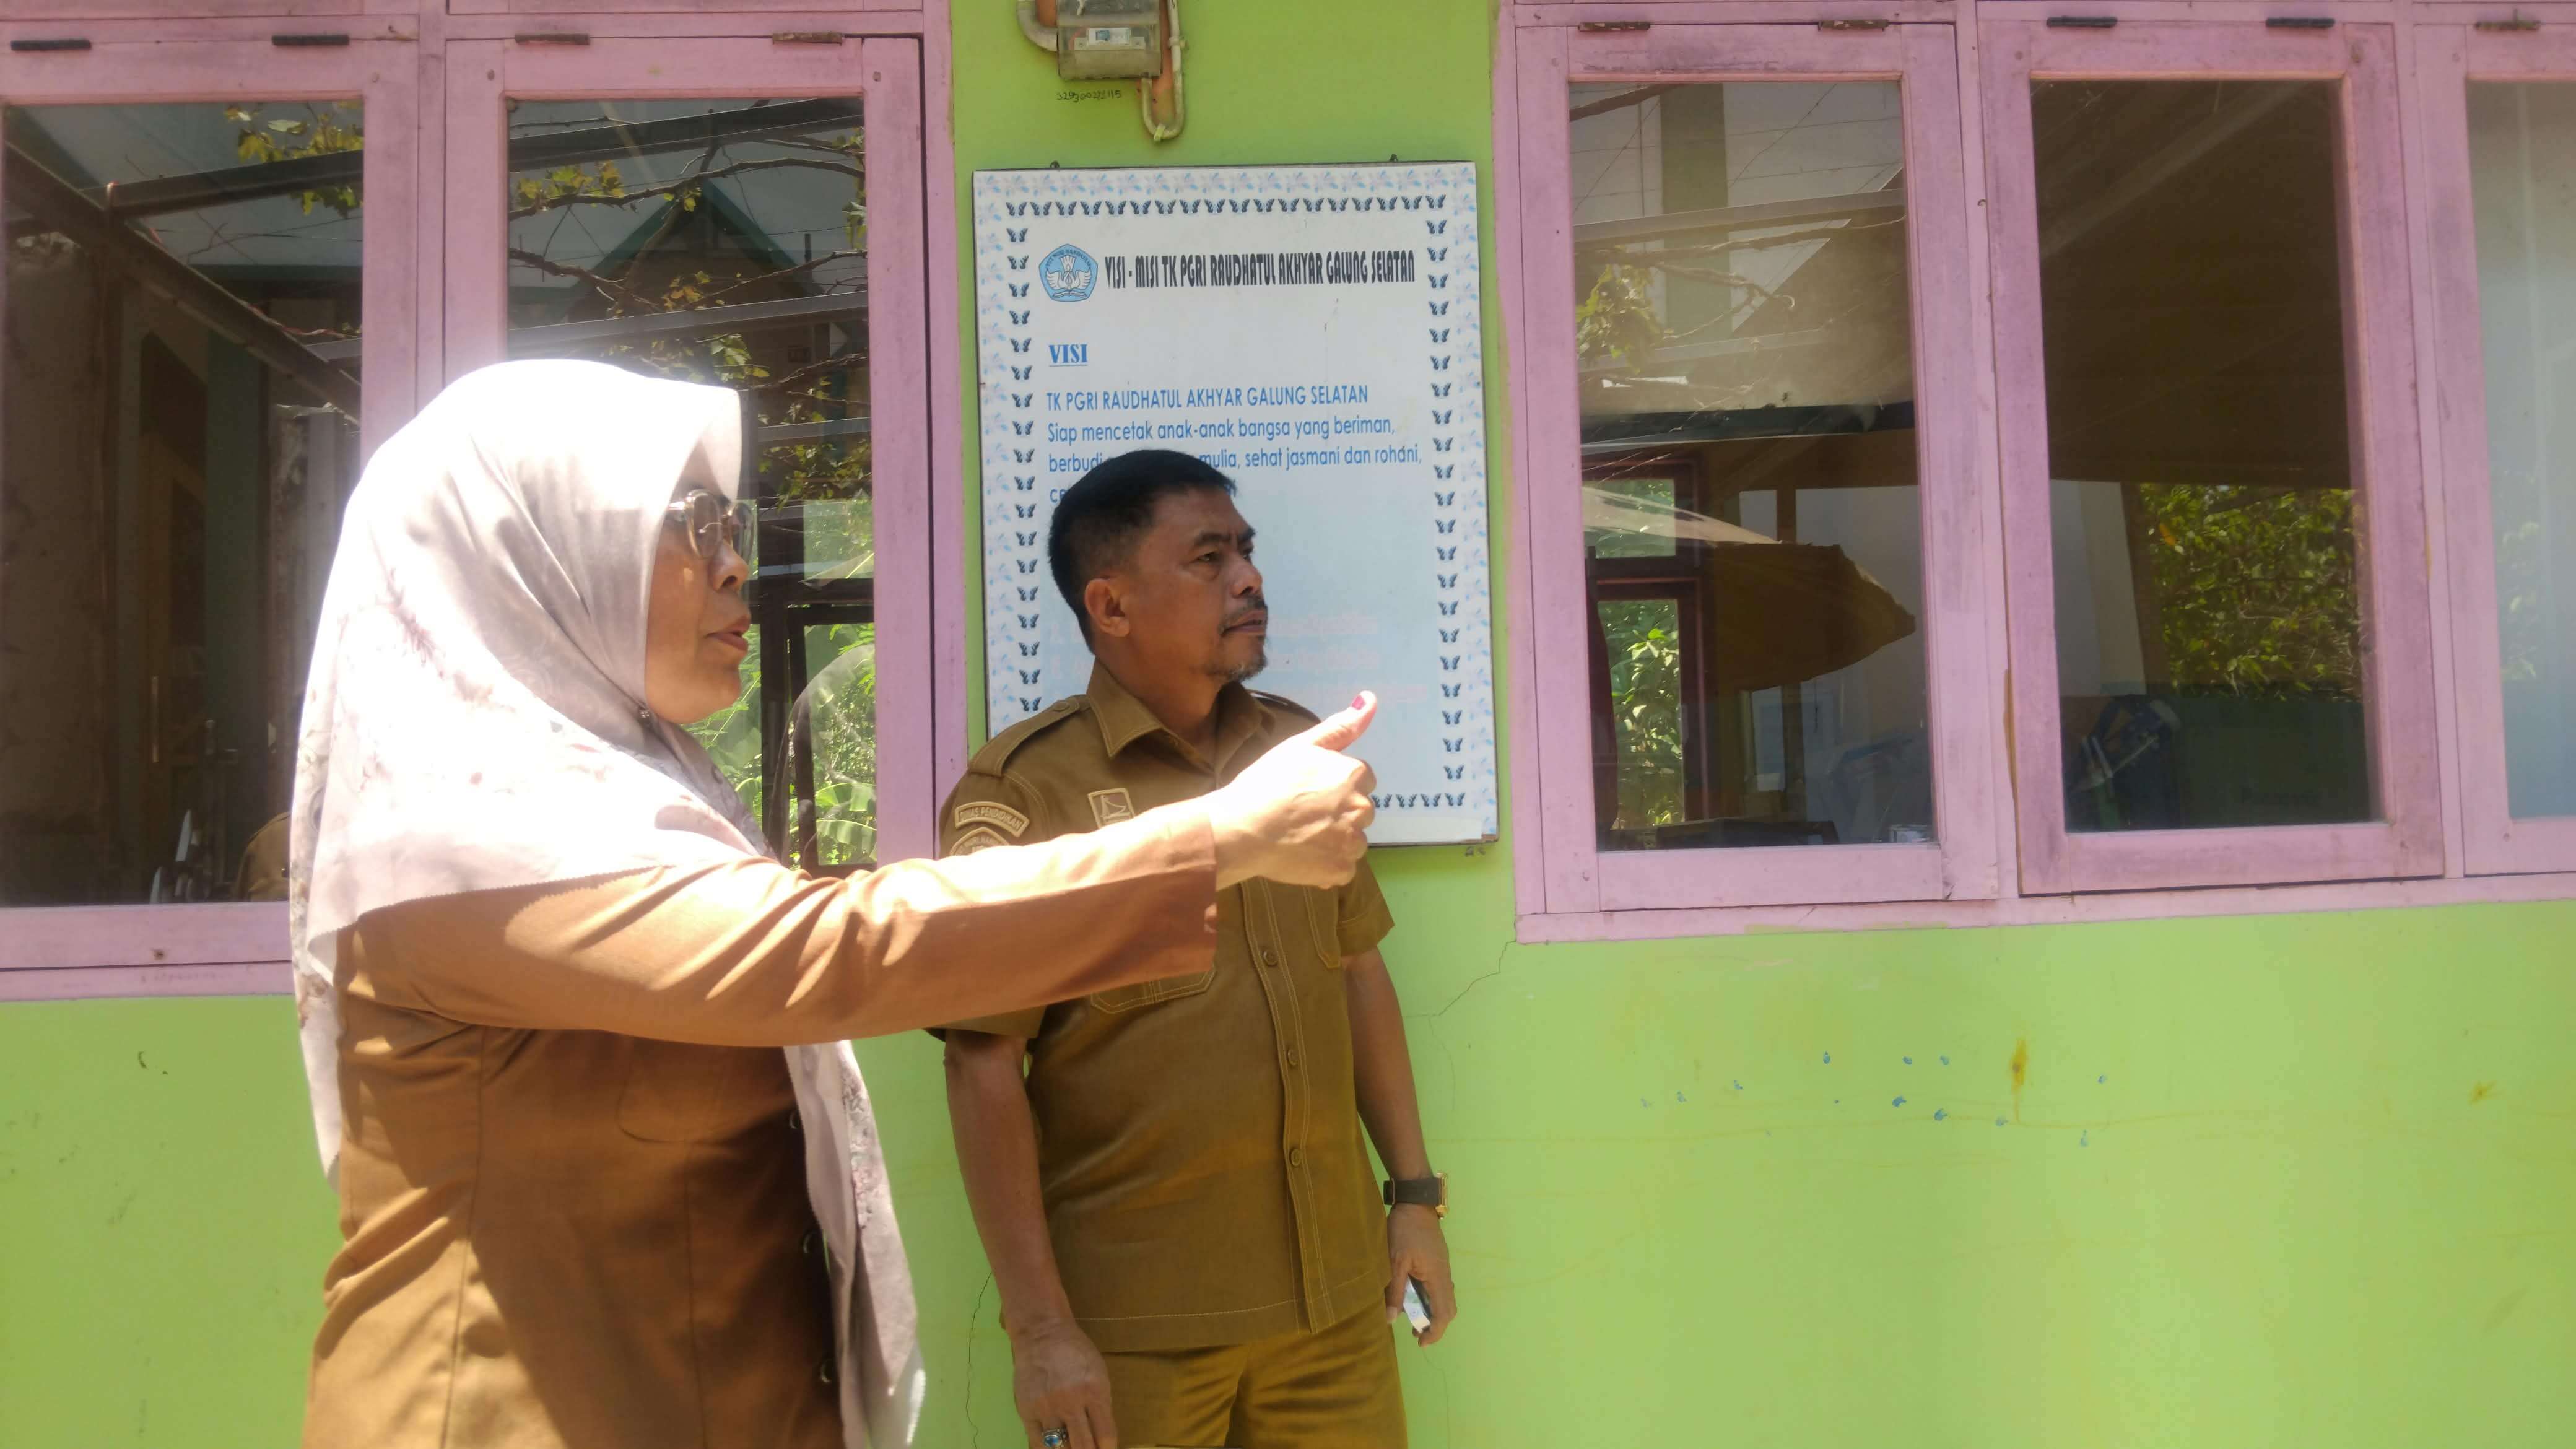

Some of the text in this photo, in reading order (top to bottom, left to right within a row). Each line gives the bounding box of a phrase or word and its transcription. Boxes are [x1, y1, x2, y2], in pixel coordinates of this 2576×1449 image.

[1105, 256, 1126, 289] VISI
[1135, 255, 1159, 288] MISI
[1162, 255, 1178, 287] TK
[1180, 254, 1207, 287] PGRI
[1210, 253, 1276, 287] RAUDHATUL
[1278, 251, 1323, 285] AKHYAR
[1326, 251, 1368, 284] GALUNG
[1372, 250, 1416, 284] SELATAN
[1048, 344, 1088, 364] VISI
[1046, 385, 1368, 411] TK PGRI RAUDHATUL AKHYAR GALUNG SELATAN
[1048, 415, 1395, 446] Siap mencetak anak-anak bangsa yang beriman,
[1245, 448, 1282, 467] sehat
[1286, 446, 1340, 471] jasmani
[1344, 446, 1371, 464] dan
